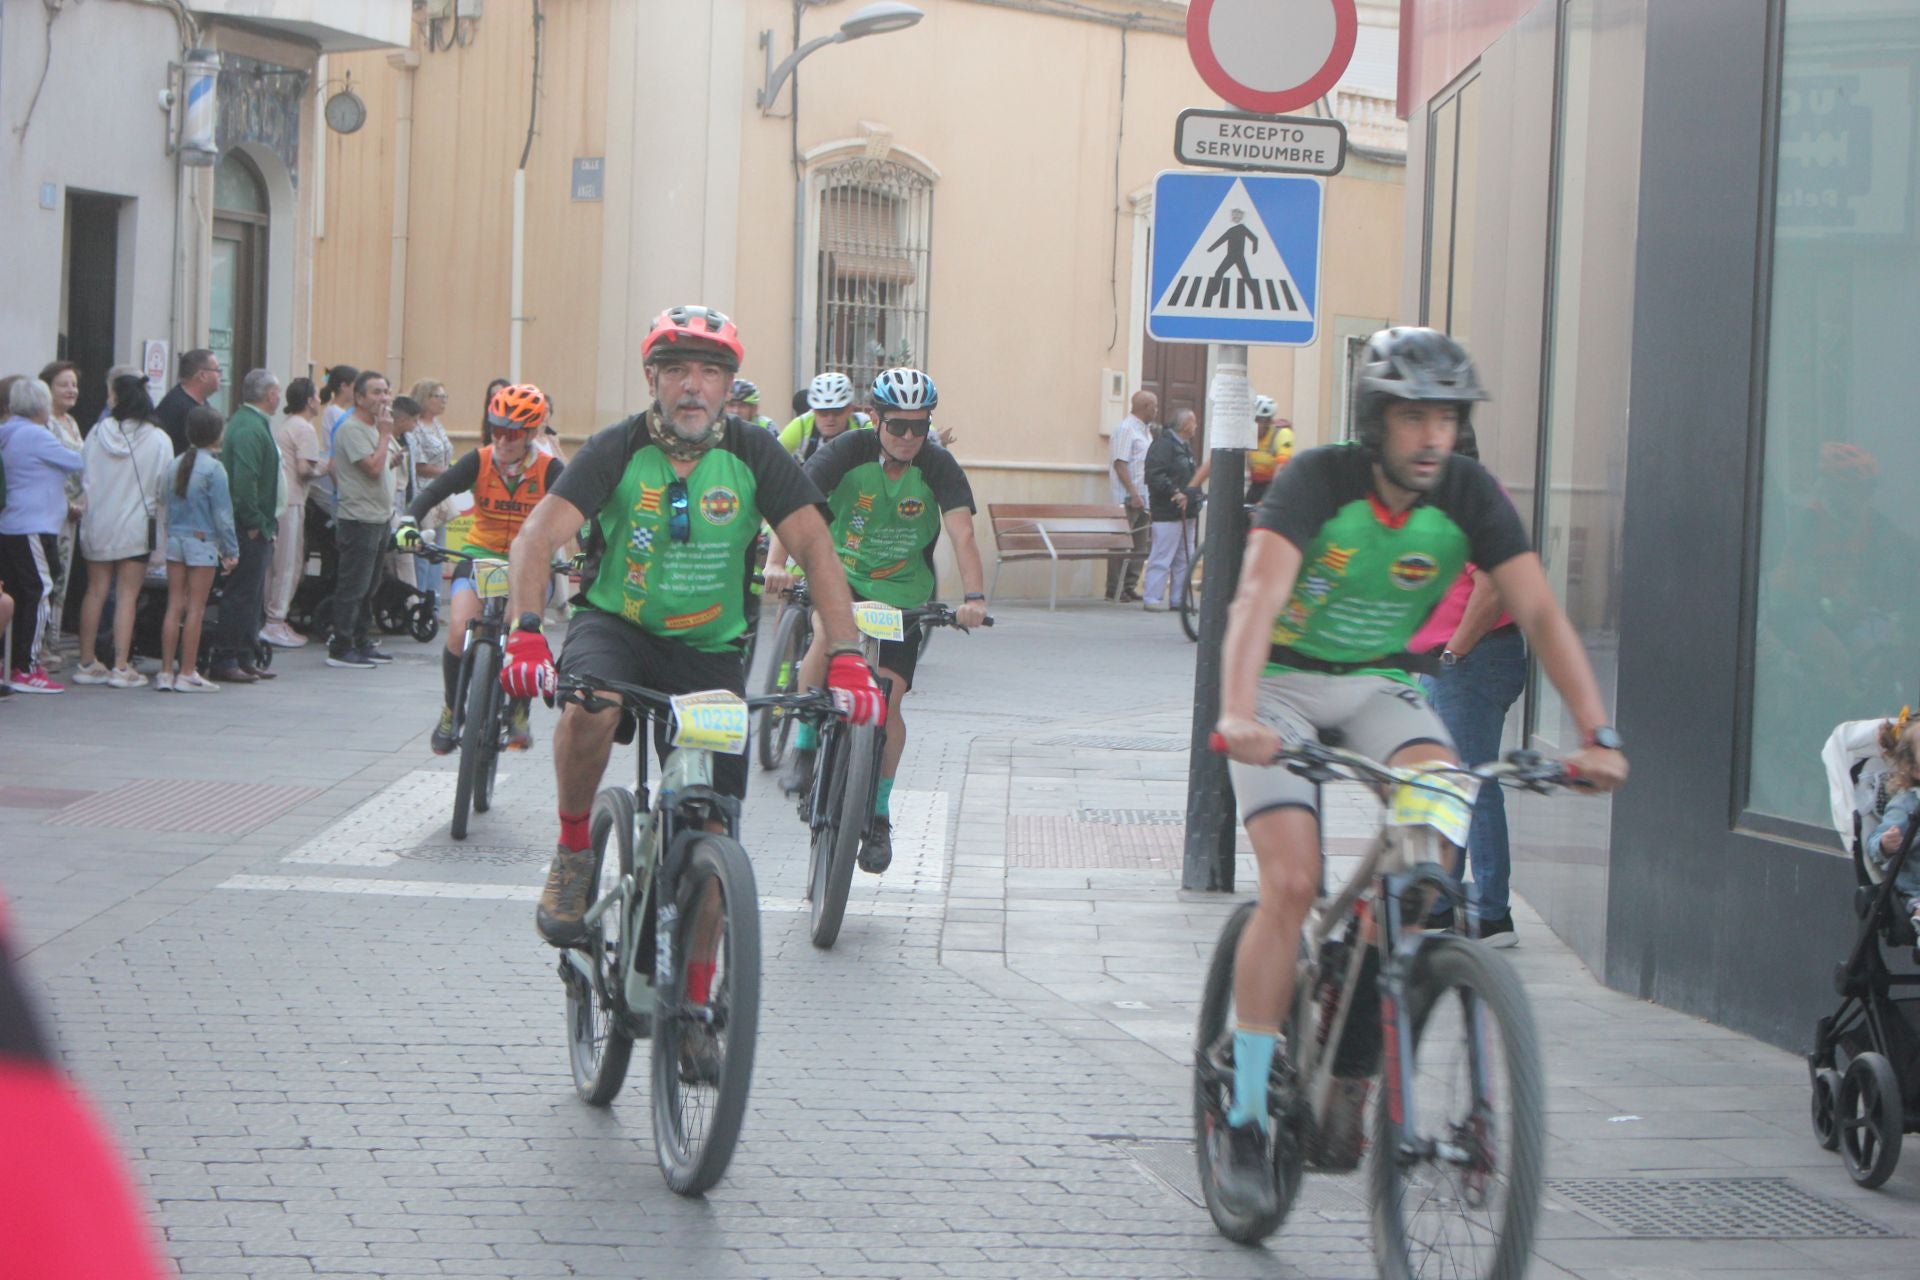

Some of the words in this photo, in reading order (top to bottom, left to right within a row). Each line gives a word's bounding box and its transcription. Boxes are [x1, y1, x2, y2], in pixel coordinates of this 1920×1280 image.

[1219, 123, 1305, 143] EXCEPTO
[1195, 140, 1325, 164] SERVIDUMBRE
[864, 610, 900, 627] 10261
[692, 708, 745, 732] 10232
